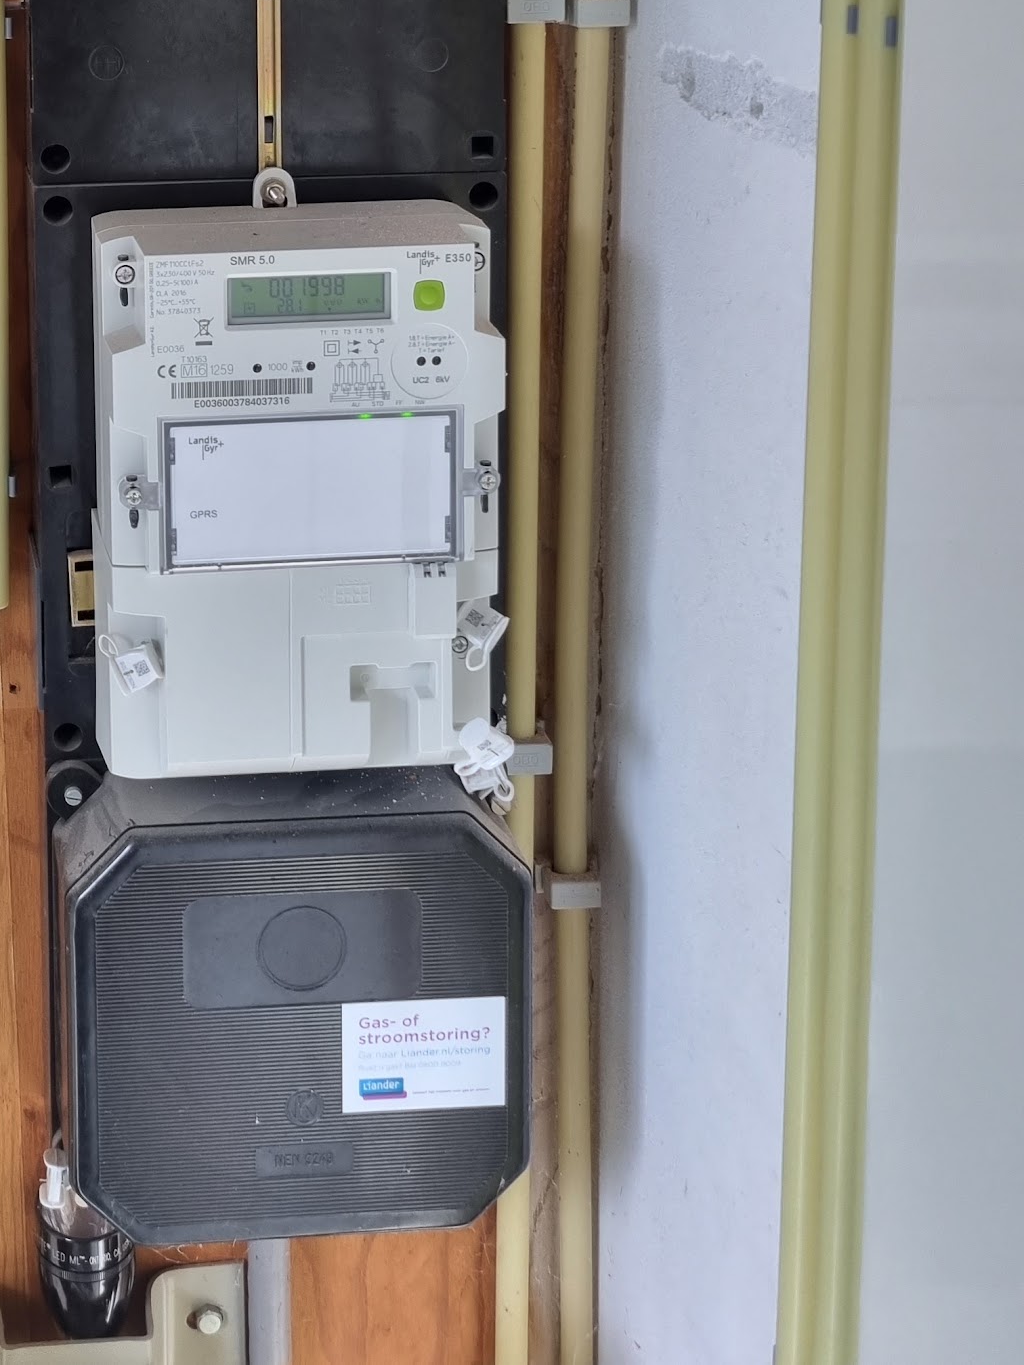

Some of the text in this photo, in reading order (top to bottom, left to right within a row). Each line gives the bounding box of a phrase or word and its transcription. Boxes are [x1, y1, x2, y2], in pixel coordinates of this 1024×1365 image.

[230, 255, 275, 266] SMR 5.0
[445, 254, 471, 263] E350
[182, 364, 234, 376] M16 1259
[268, 363, 288, 371] 1000
[194, 397, 290, 408] E0036003784037316
[190, 510, 218, 519] GPRS
[359, 1014, 420, 1029] Gas- of
[359, 1027, 491, 1045] stroomstoring?
[401, 1046, 491, 1058] Liander.nl/storing
[362, 1080, 400, 1091] Liander
[52, 1250, 66, 1262] LED
[89, 1252, 111, 1265] ONTRIO,
